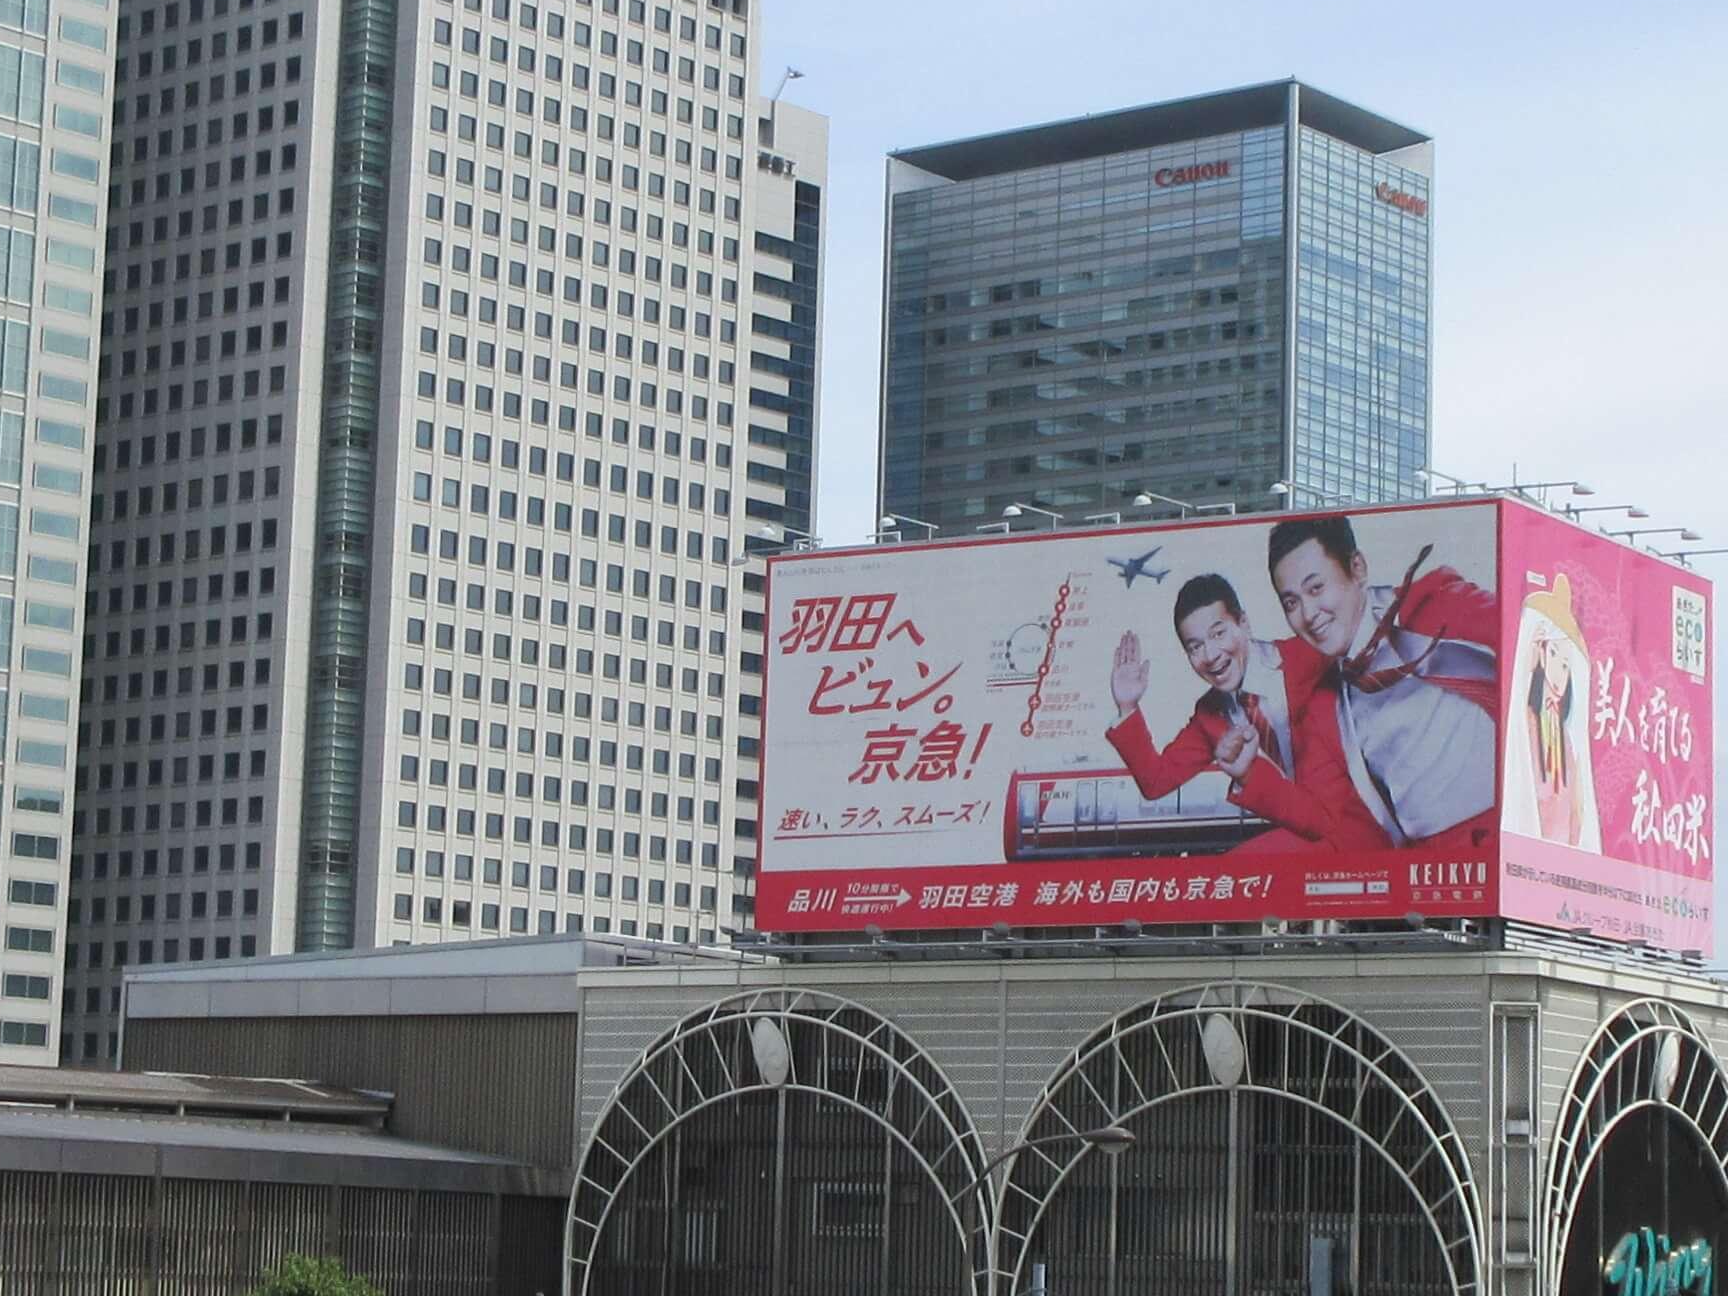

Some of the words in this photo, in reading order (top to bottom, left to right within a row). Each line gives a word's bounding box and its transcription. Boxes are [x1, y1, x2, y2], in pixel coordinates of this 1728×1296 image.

[1154, 160, 1232, 188] Canon
[1375, 180, 1427, 217] Canon
[778, 593, 925, 654] 羽田へ
[1675, 615, 1702, 643] eco
[808, 657, 964, 715] ビュン。
[1594, 656, 1692, 764] 美人を育てる
[1631, 769, 1710, 865] 秋田米
[1409, 862, 1487, 886] KEIKYU
[787, 888, 838, 913] 品川
[919, 882, 1019, 909] 羽田空港
